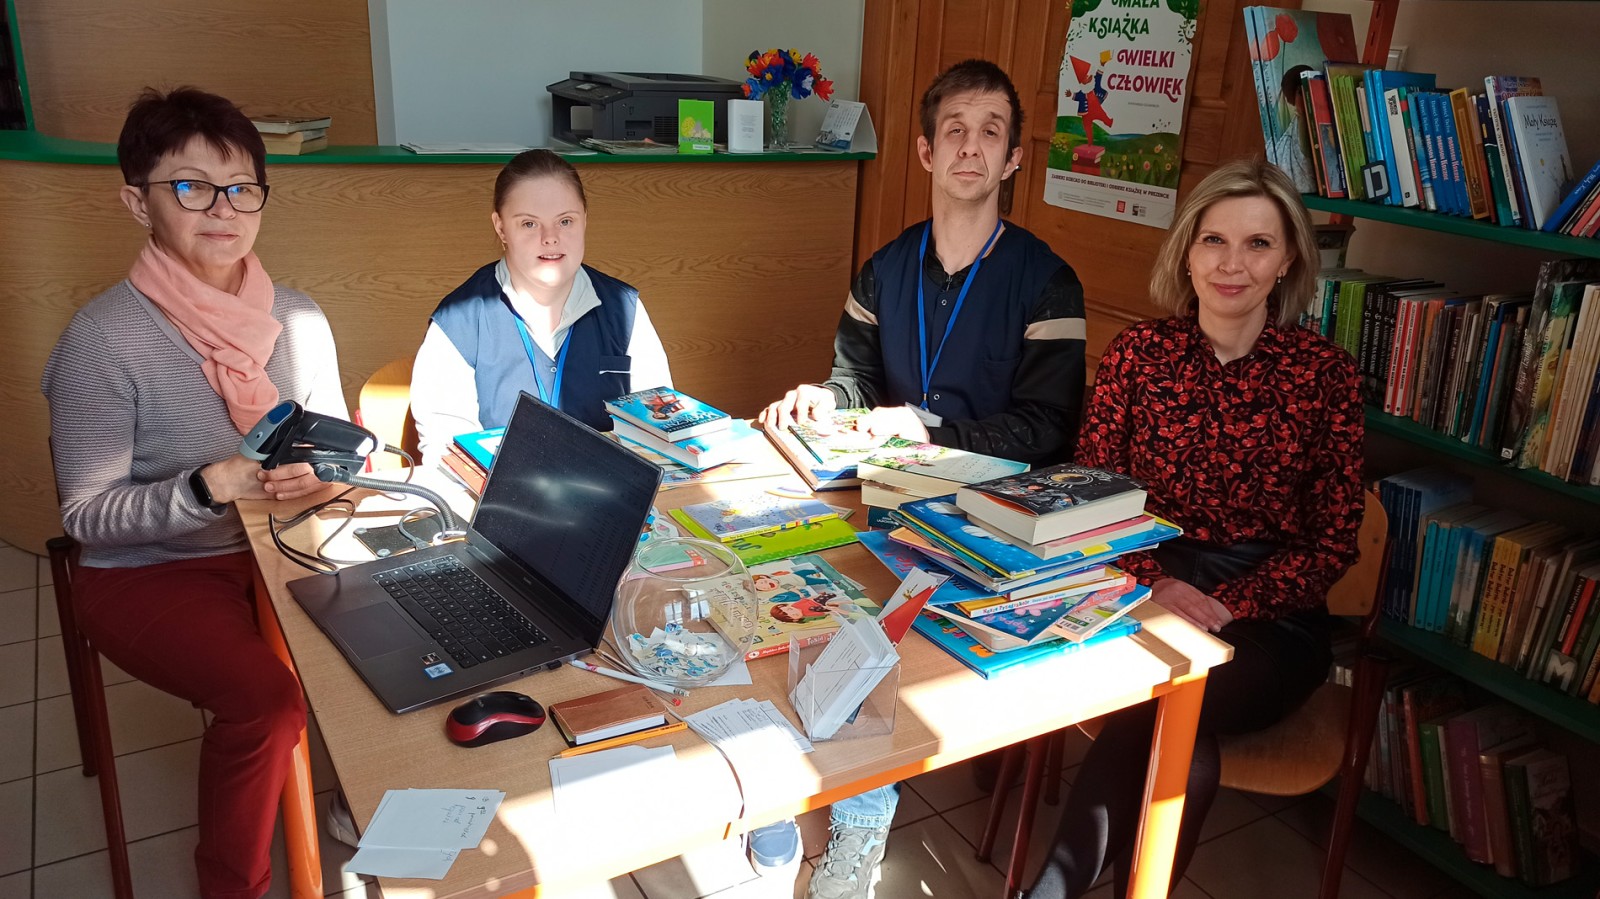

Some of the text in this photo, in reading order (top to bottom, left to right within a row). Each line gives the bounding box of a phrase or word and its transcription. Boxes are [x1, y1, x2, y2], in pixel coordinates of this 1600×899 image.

[1088, 12, 1149, 41] KSIĄŻKA
[1117, 49, 1175, 67] WIELKI
[1107, 73, 1183, 102] CZŁOWIEK
[1418, 99, 1427, 115] Daniel
[1429, 100, 1438, 117] Daniel
[1440, 101, 1449, 117] Daniel
[1364, 165, 1389, 199] D
[1543, 654, 1576, 692] M
